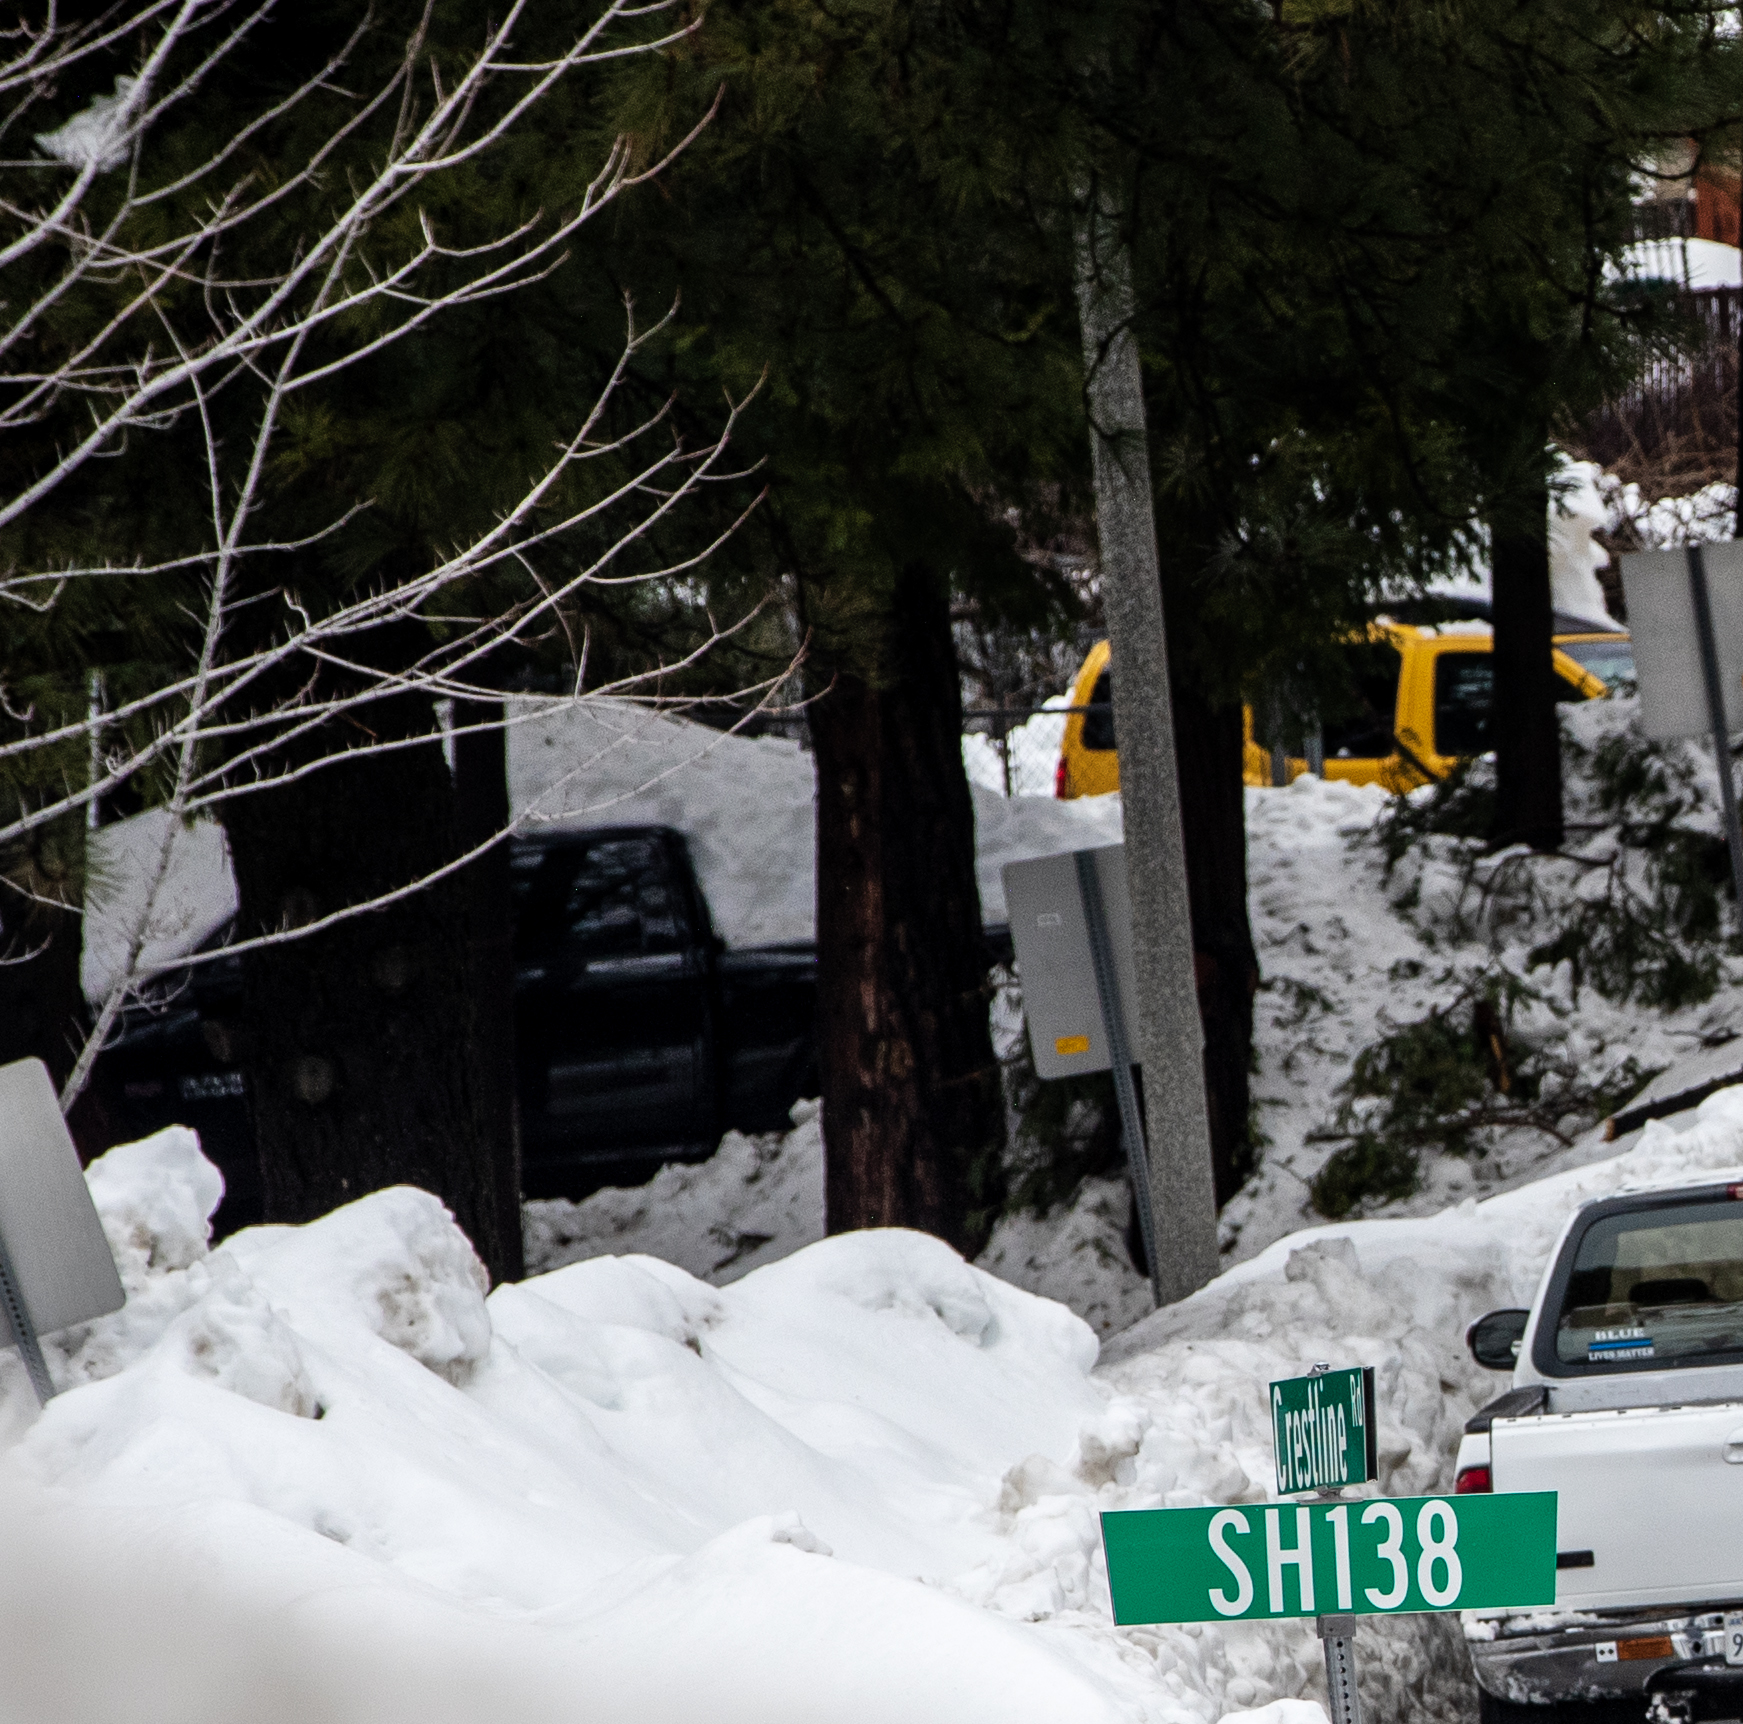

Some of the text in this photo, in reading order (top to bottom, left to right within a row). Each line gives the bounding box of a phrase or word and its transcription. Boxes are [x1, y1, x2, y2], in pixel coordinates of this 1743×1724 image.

[1594, 1327, 1646, 1340] BLUE
[1273, 1373, 1363, 1492] Crestline Rd
[1207, 1499, 1462, 1617] SH138
